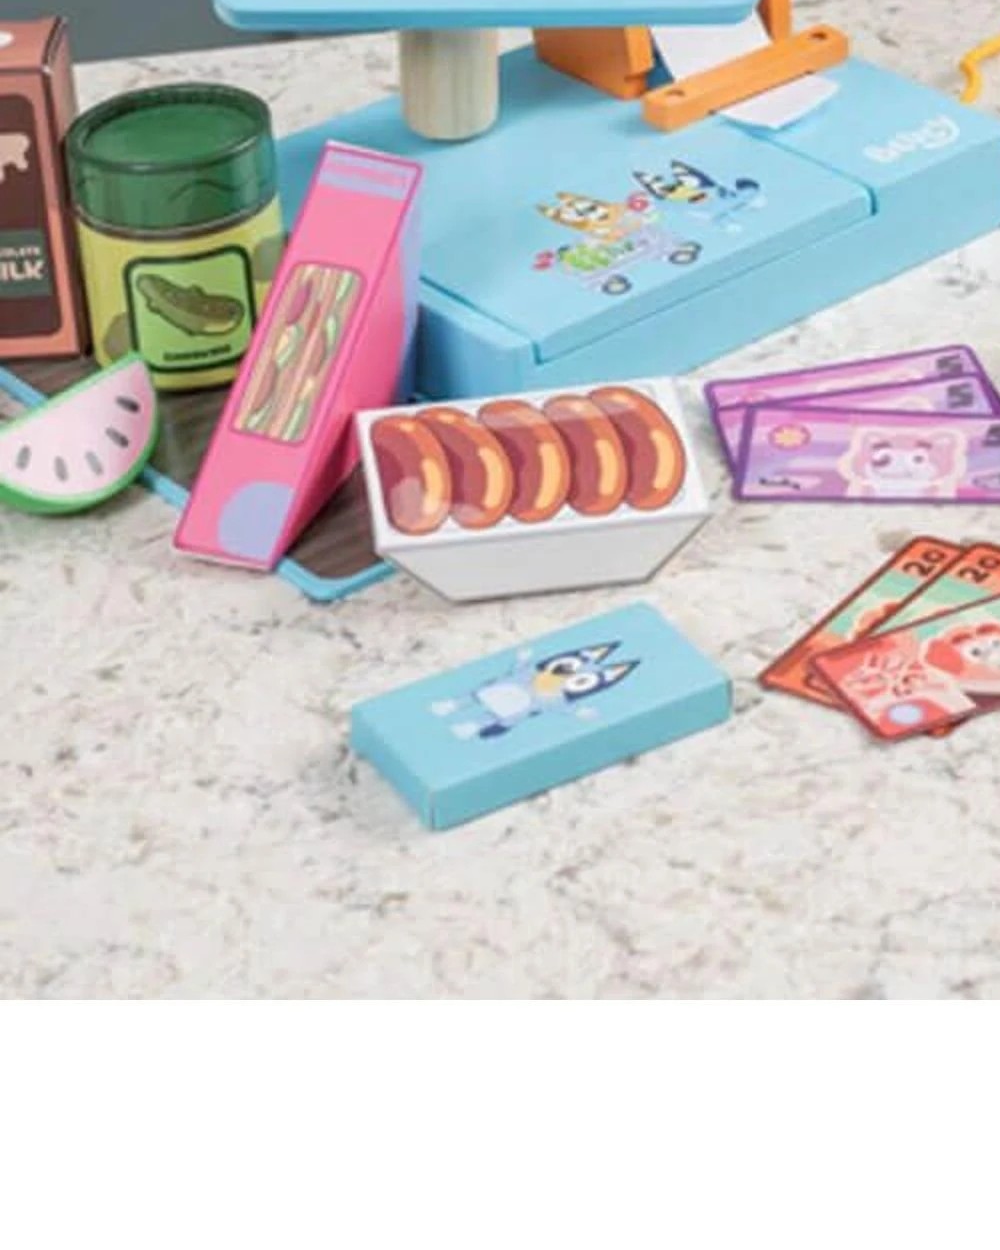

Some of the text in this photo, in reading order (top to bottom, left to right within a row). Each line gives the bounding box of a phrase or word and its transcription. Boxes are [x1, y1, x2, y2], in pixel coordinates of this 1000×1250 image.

[0, 260, 45, 282] ILK
[947, 383, 974, 409] 5
[902, 549, 946, 578] 20
